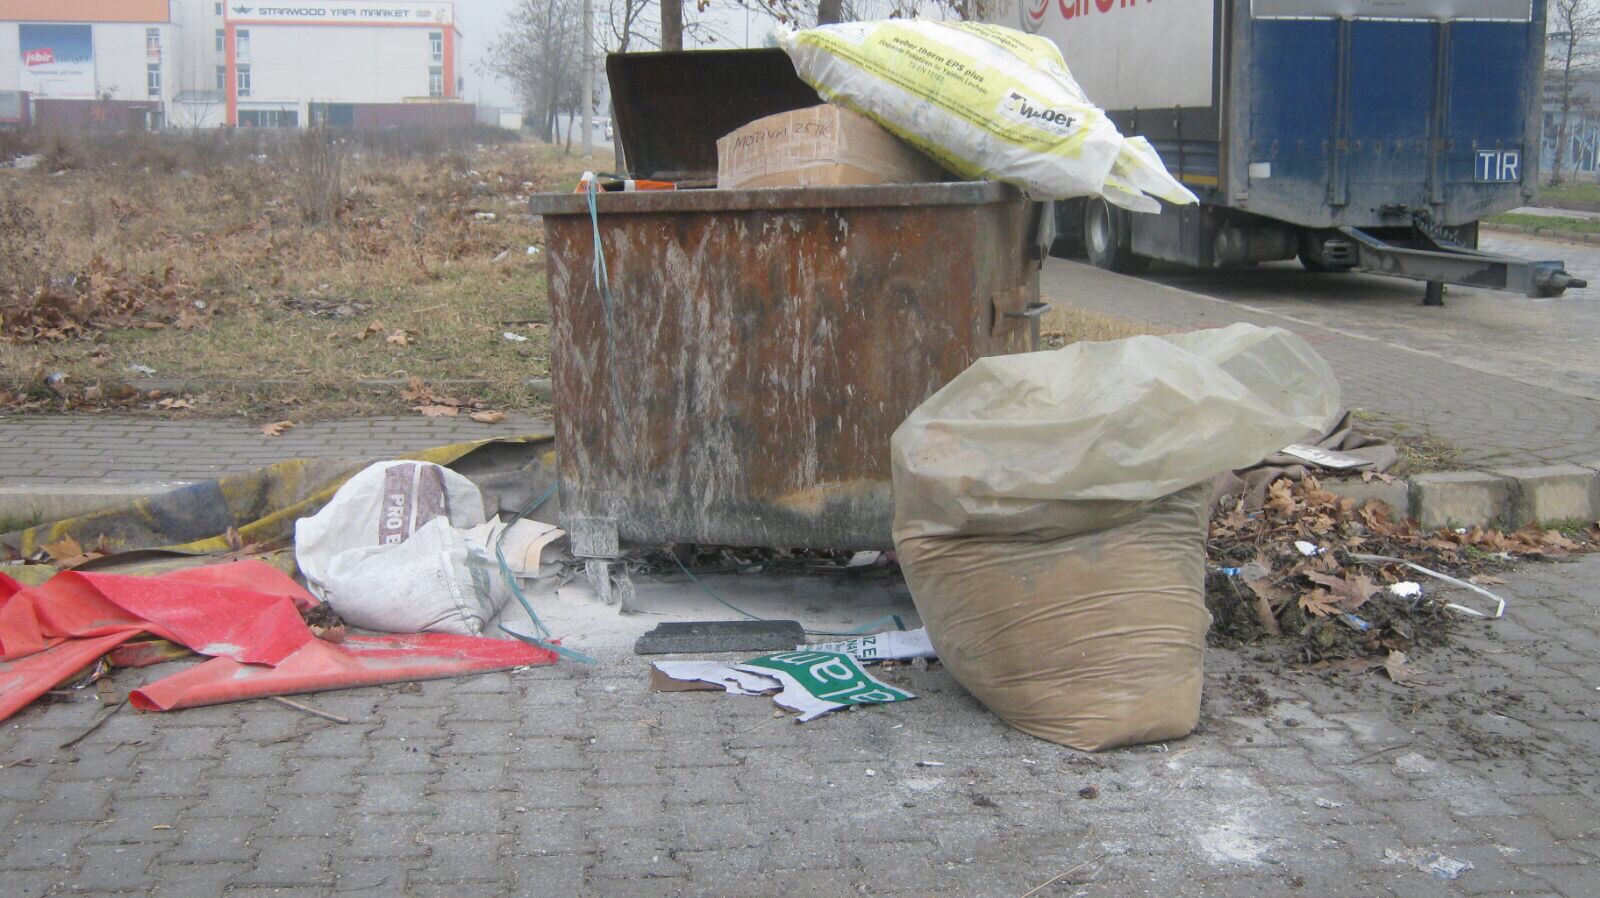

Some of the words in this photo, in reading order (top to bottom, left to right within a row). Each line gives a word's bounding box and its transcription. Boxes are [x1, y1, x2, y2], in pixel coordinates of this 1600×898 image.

[258, 7, 326, 16] STARWOOD
[331, 8, 356, 17] YAPI
[360, 8, 410, 17] MARKET
[945, 58, 966, 72] EPS
[963, 68, 985, 83] plus
[1479, 152, 1518, 180] TIR
[386, 494, 405, 529] PRO
